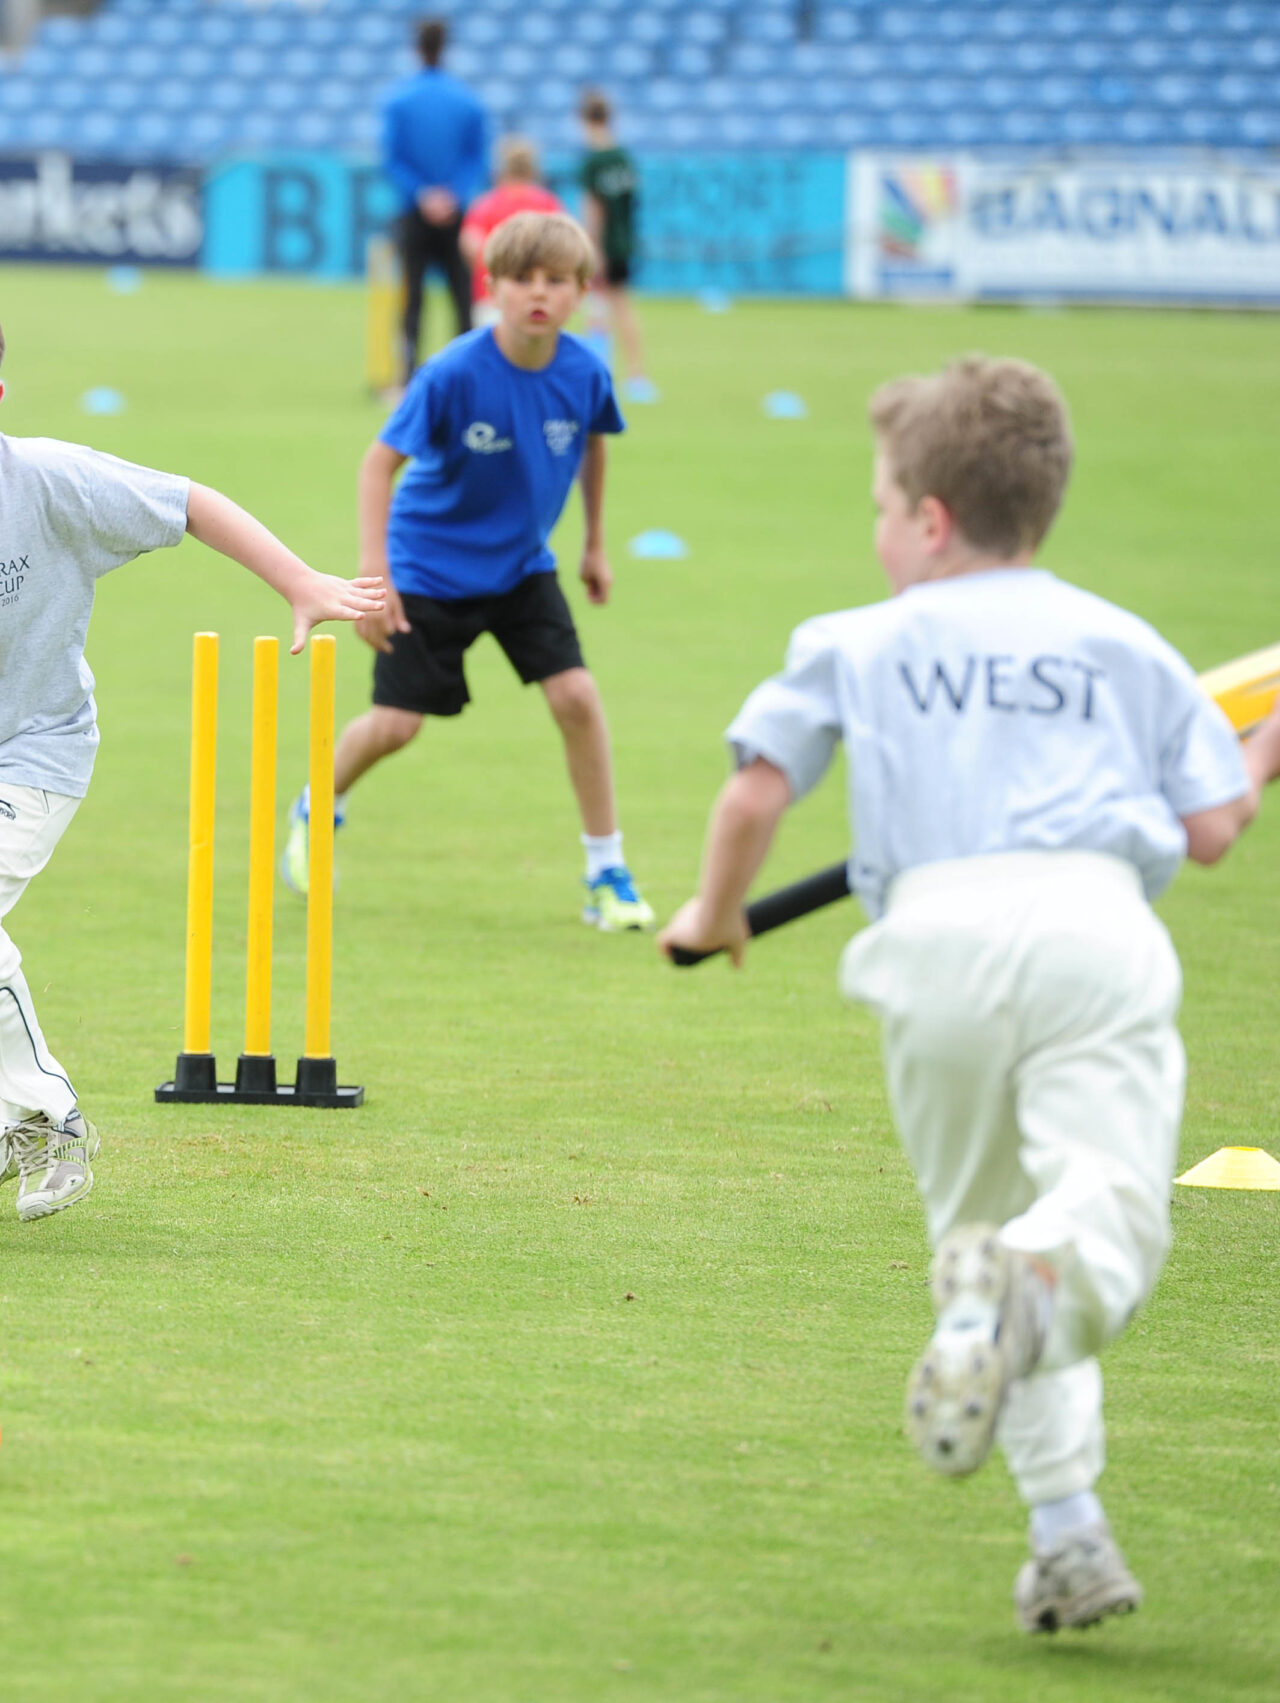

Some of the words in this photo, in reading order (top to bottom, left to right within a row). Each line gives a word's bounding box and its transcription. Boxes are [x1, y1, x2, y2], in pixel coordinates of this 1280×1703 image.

[969, 182, 1280, 243] BAGNAL
[1, 595, 20, 607] 2016
[896, 654, 1108, 724] WEST
